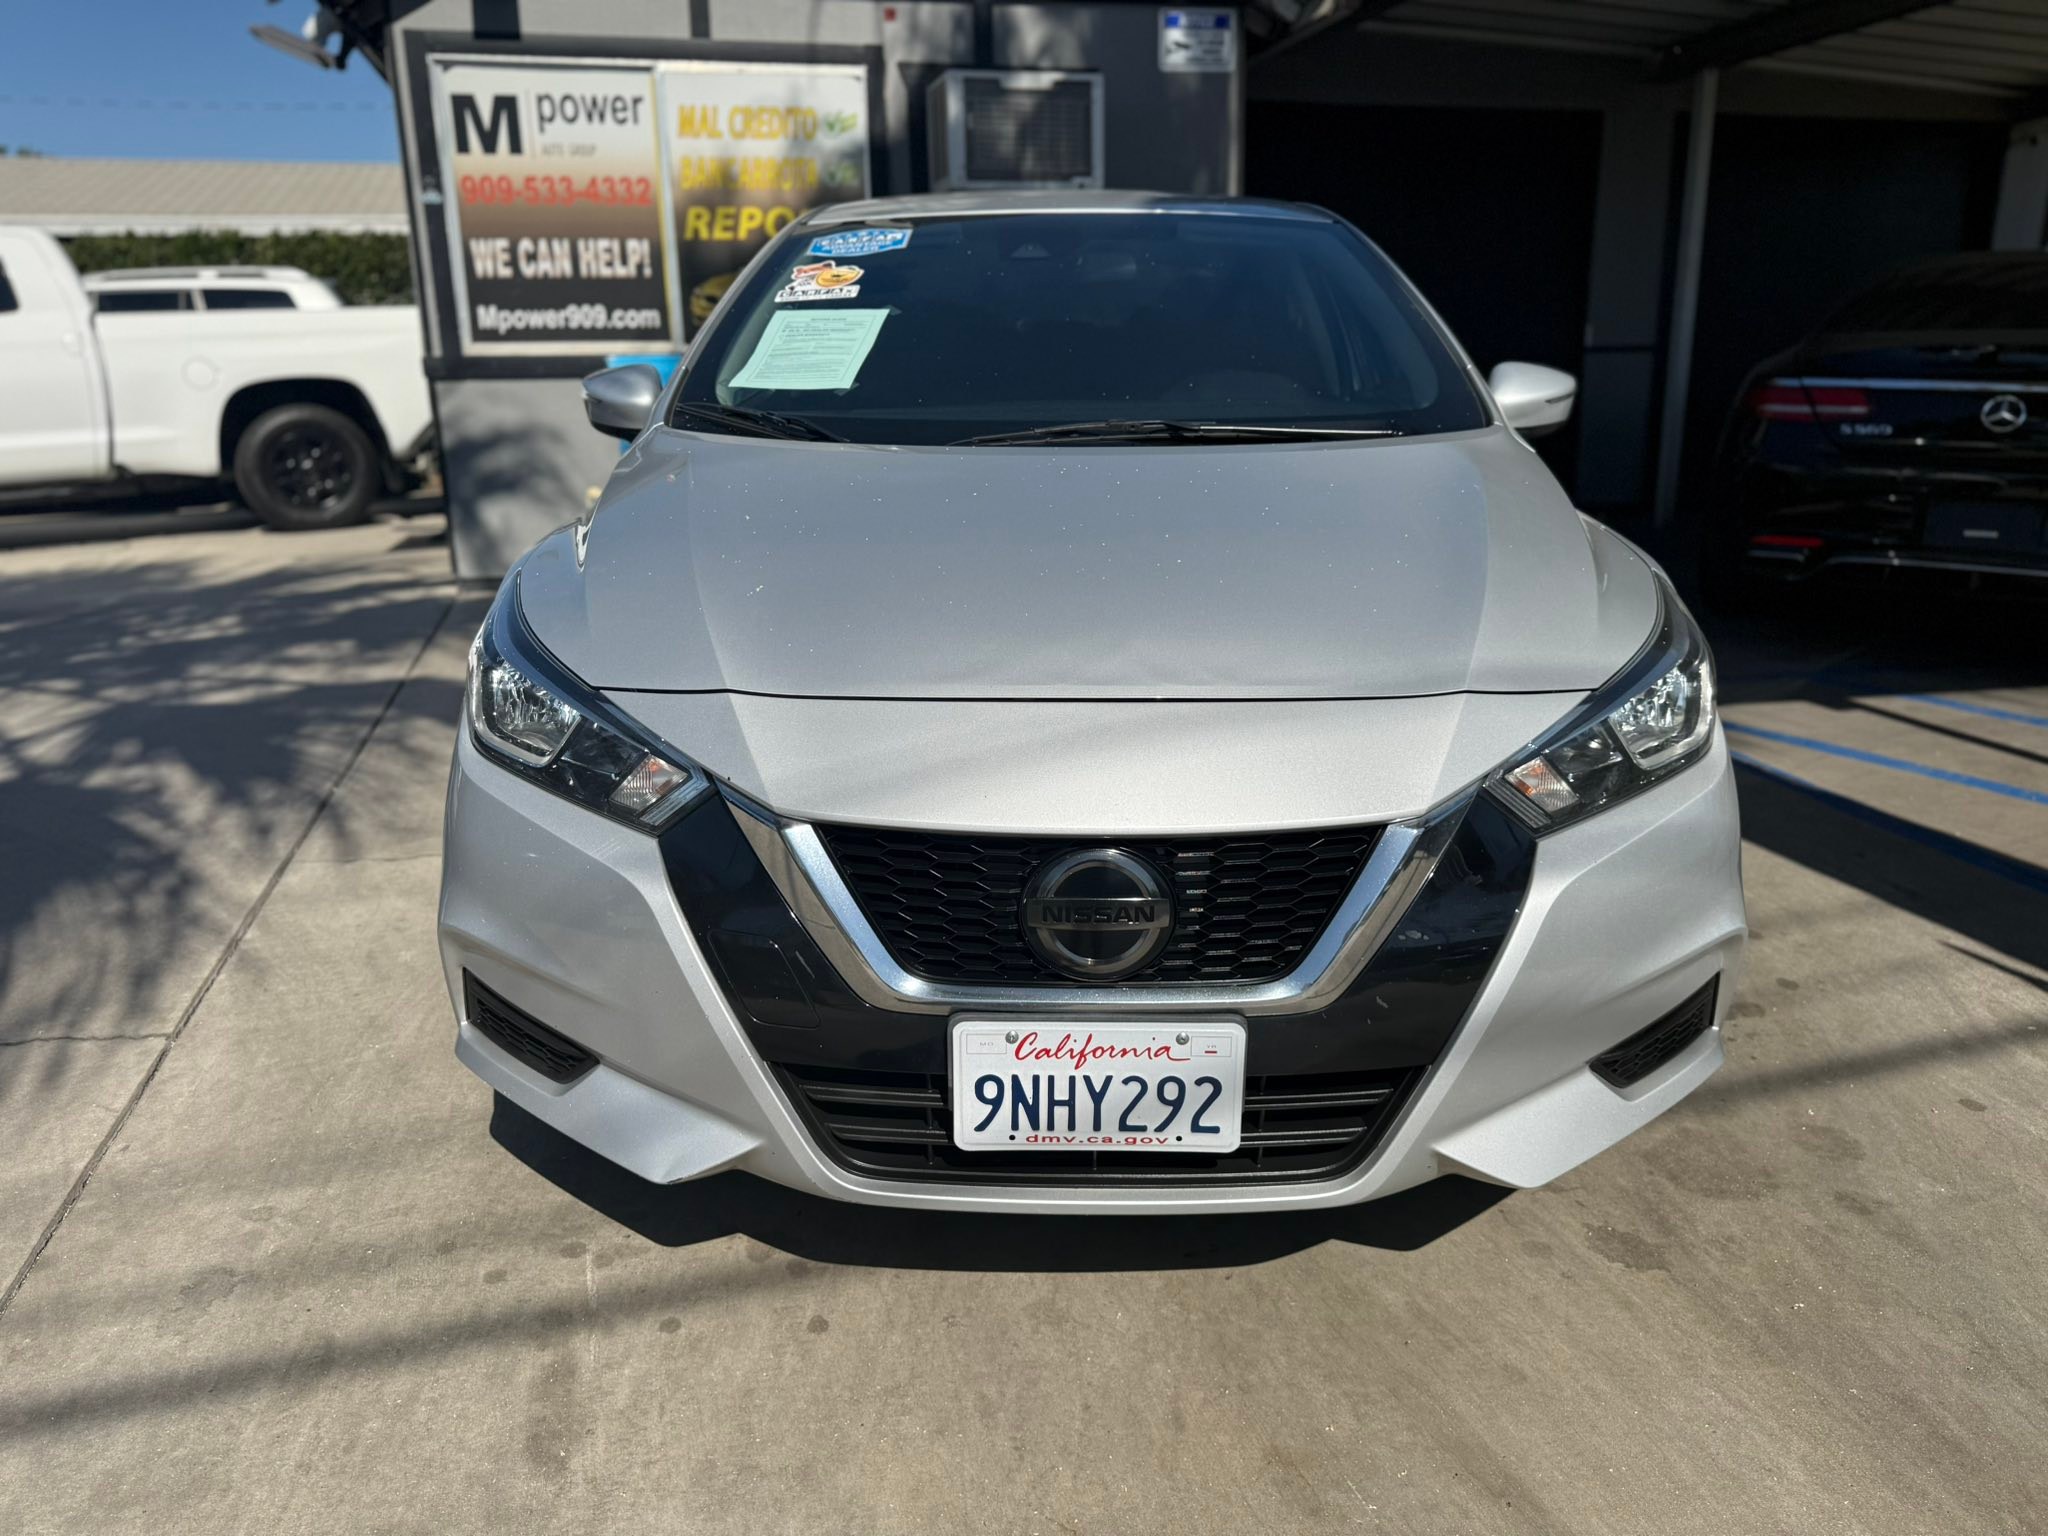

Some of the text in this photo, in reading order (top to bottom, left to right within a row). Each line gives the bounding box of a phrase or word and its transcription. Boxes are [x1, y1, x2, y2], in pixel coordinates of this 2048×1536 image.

[451, 93, 644, 154] M power
[678, 104, 723, 139] MAL
[460, 175, 652, 207] 909-533-4332
[684, 205, 807, 241] REPO
[469, 237, 653, 279] WE CAN HELP!
[476, 303, 662, 334] Mpower909.com
[1042, 904, 1156, 924] NISSAN
[1014, 1031, 1191, 1070] California
[973, 1073, 1223, 1134] 9NHY292
[1025, 1133, 1169, 1146] dmv.ca.gov
